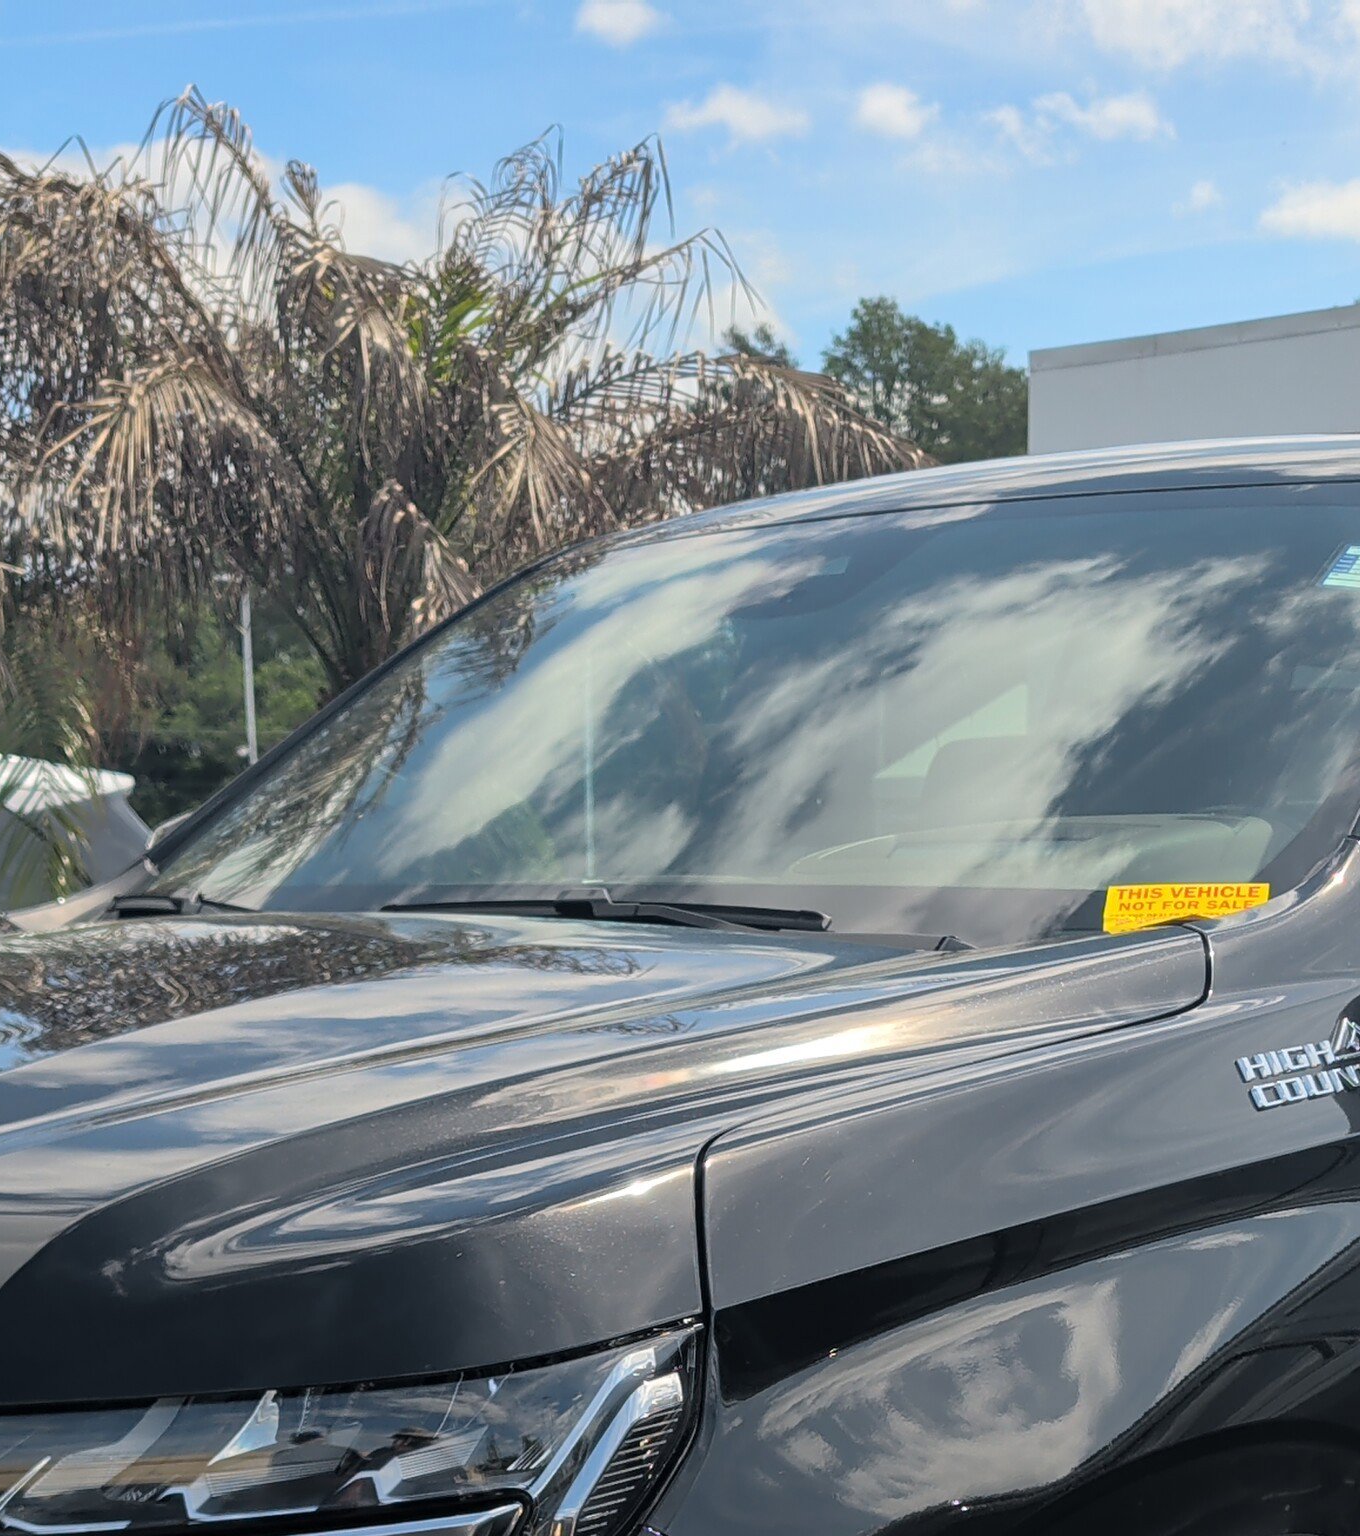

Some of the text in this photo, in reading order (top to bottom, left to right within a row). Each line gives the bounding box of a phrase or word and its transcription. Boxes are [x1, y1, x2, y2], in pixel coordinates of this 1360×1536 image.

[1117, 885, 1261, 900] THIS VEHICLE
[1119, 899, 1256, 911] NOT FOR SALE
[1236, 1040, 1337, 1082] HIGH
